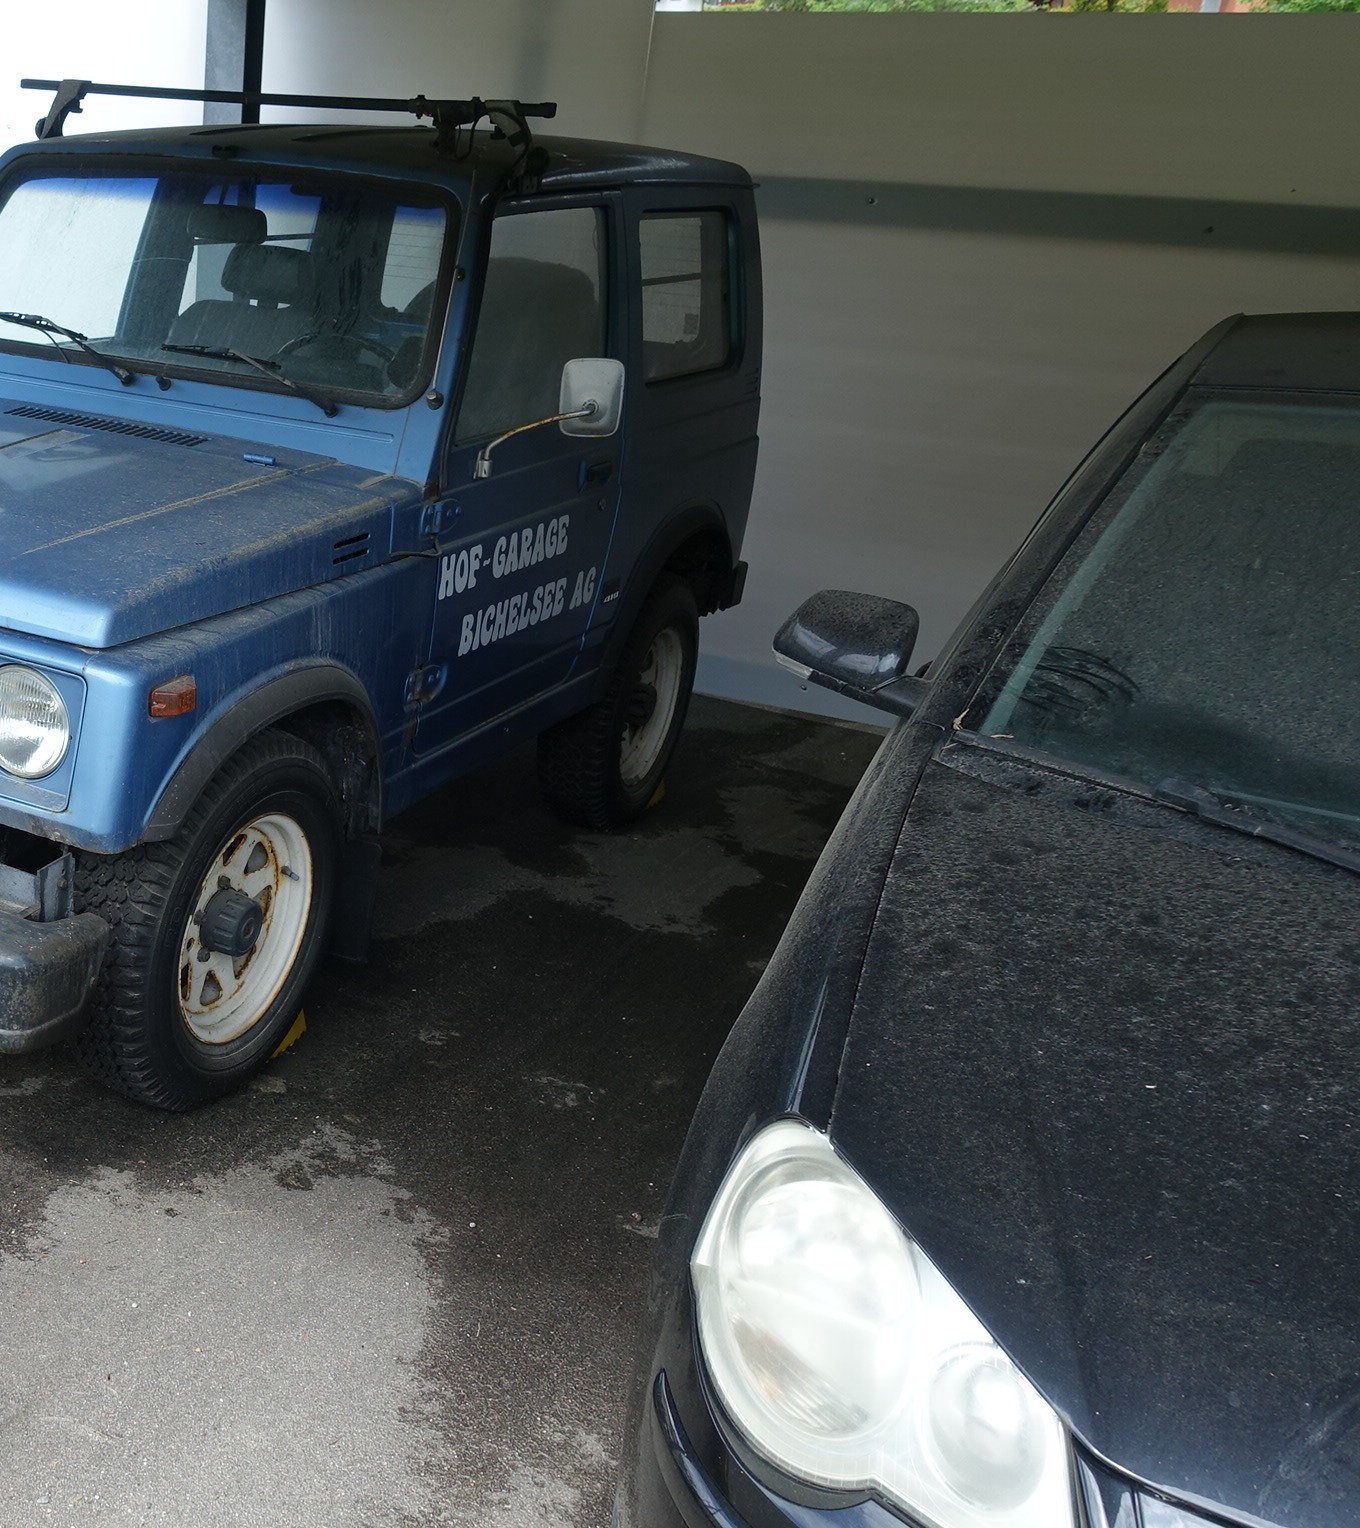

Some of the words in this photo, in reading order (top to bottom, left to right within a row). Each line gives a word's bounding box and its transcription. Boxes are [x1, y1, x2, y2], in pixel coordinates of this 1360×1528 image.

[438, 514, 569, 600] HOF-GARAGE
[457, 577, 567, 657] BICHELSEE
[568, 566, 597, 610] AG
